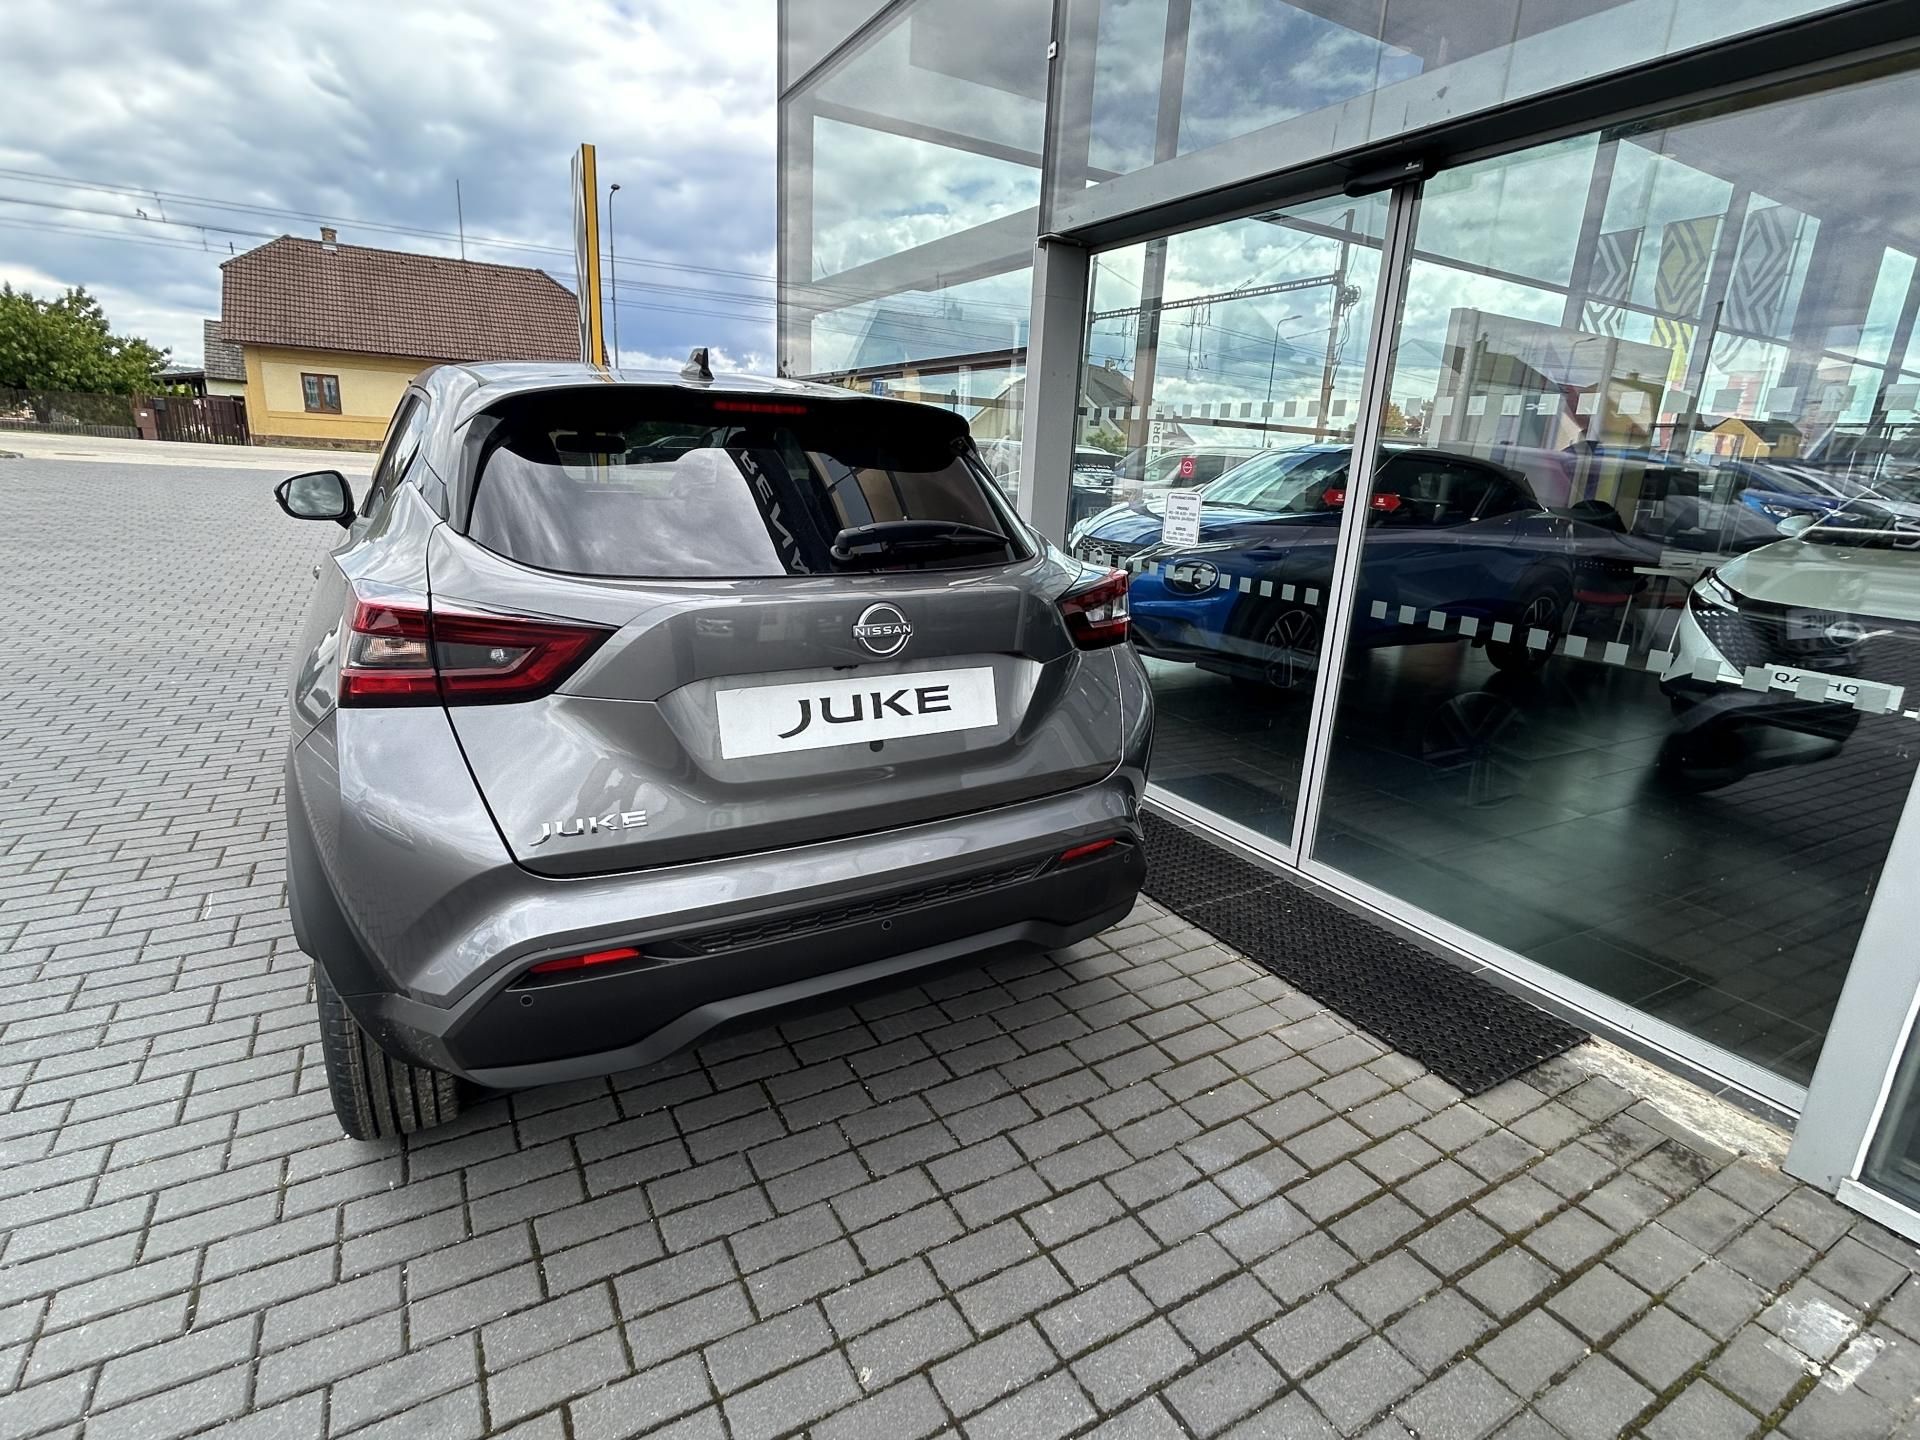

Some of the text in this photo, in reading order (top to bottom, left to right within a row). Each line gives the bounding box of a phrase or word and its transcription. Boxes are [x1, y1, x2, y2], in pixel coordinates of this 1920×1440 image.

[855, 624, 911, 637] NISSAN
[777, 684, 953, 739] JUKE
[529, 810, 648, 846] JUKE
